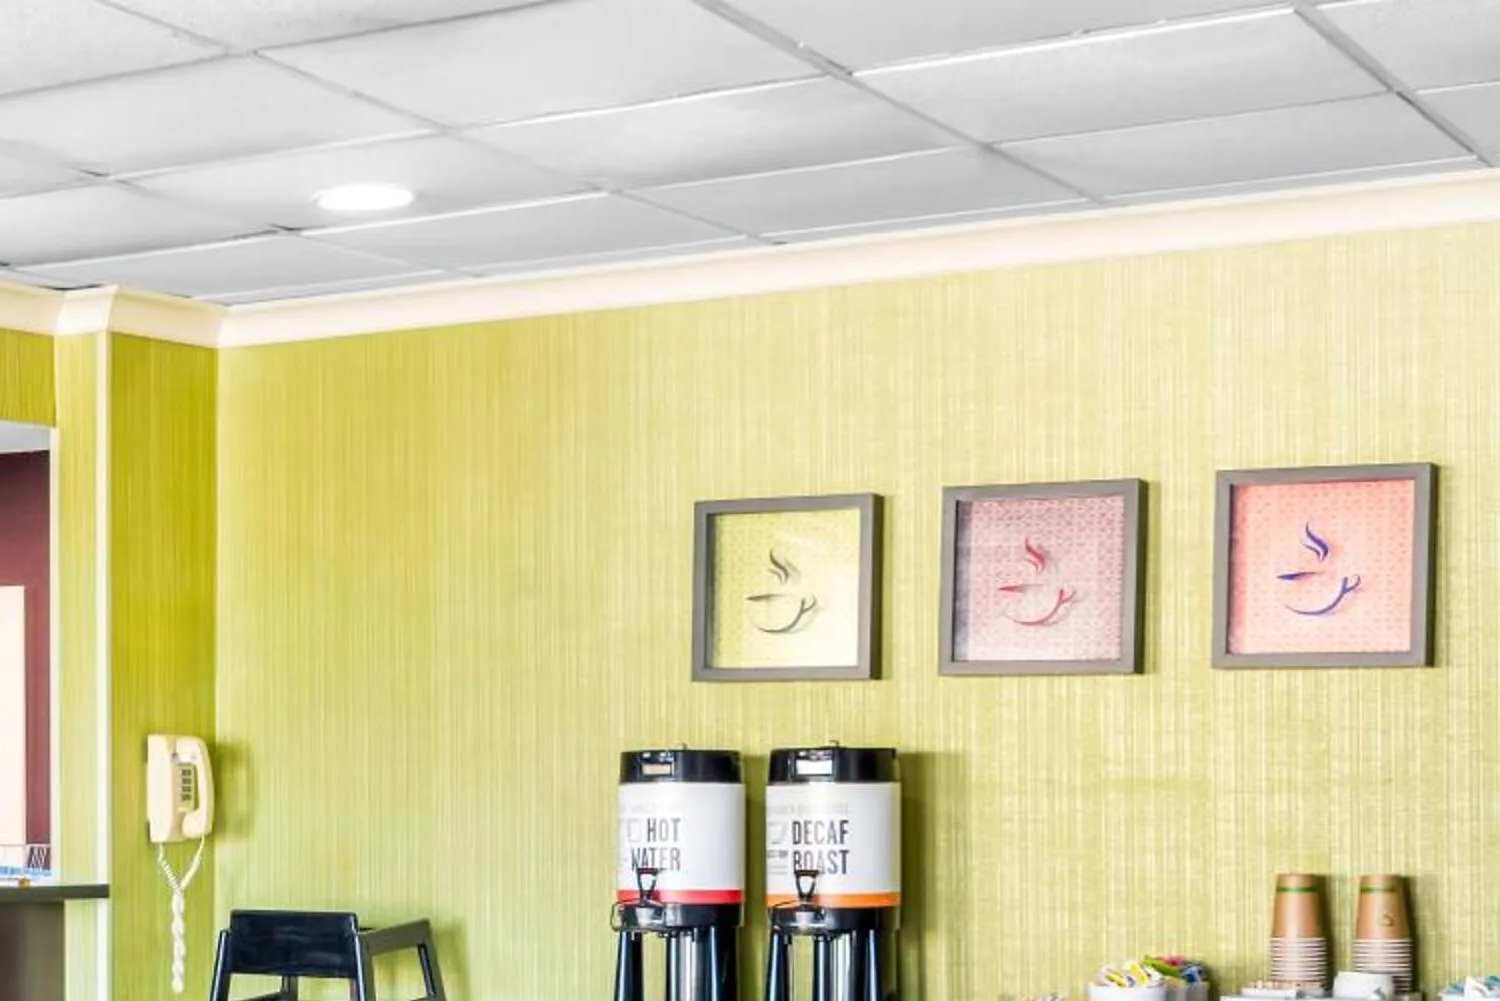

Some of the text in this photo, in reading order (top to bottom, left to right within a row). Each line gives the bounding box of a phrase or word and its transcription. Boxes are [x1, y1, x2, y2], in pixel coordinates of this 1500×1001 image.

[646, 818, 681, 842] HOT
[792, 820, 850, 845] DECAF
[793, 849, 850, 875] ROAST
